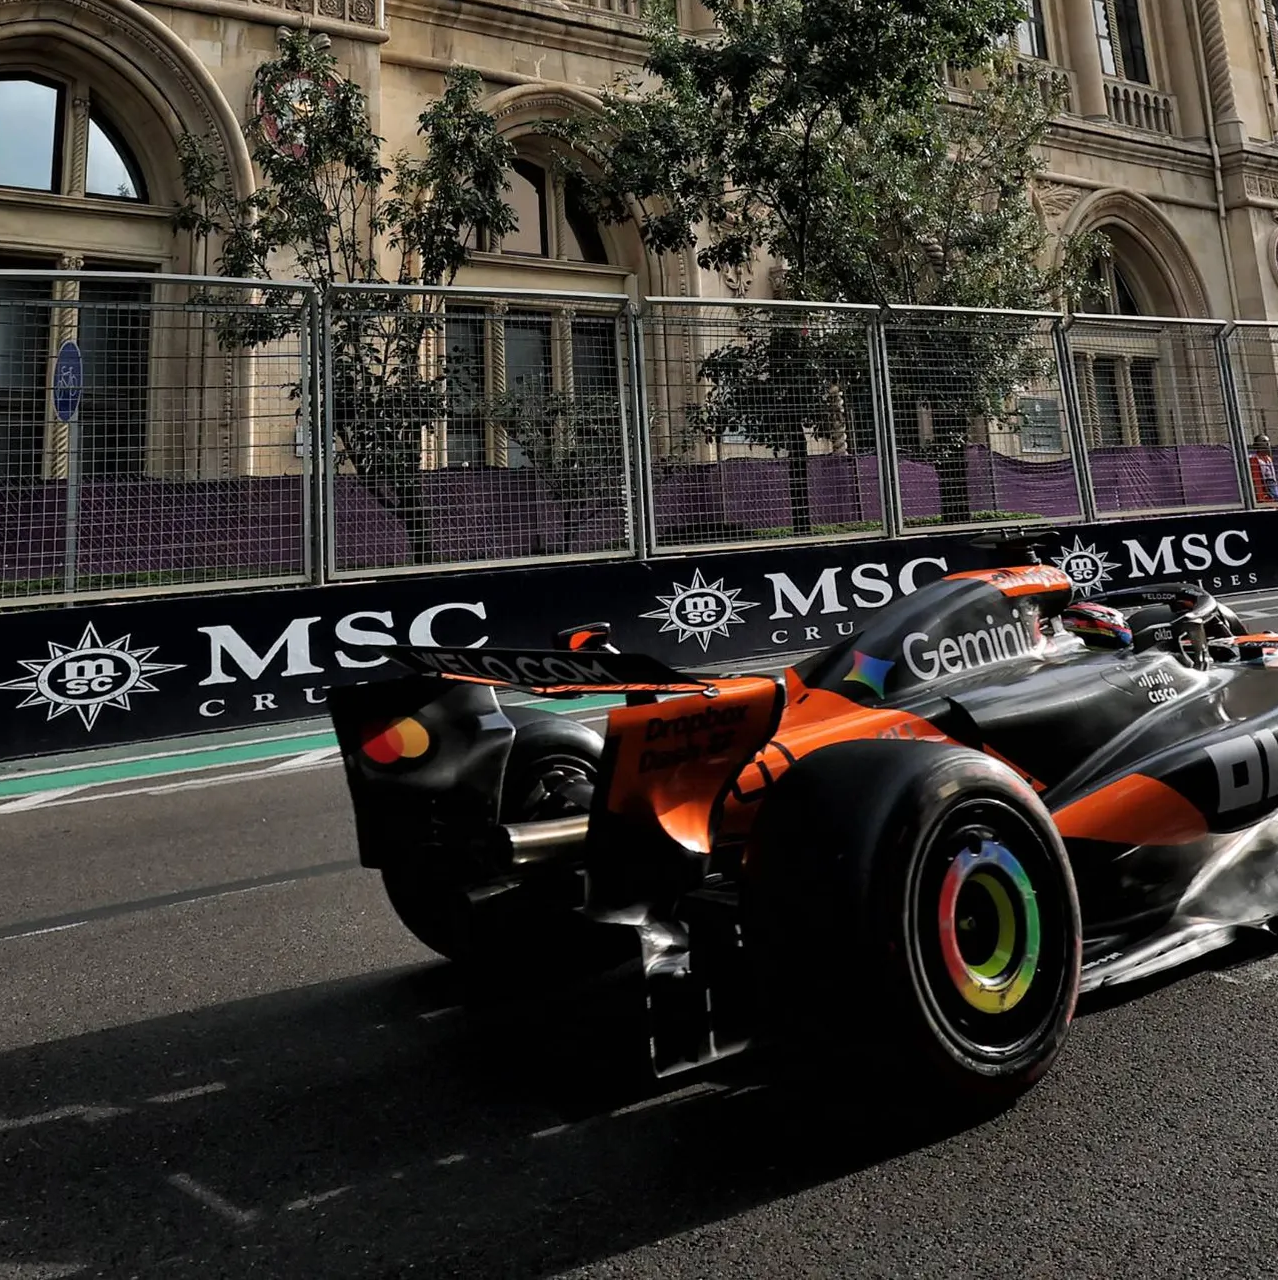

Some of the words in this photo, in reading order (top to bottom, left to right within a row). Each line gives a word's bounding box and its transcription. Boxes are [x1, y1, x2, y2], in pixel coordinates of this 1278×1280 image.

[1122, 529, 1252, 579] MSC
[764, 557, 949, 620] MSC
[197, 601, 490, 687] MSC
[902, 608, 1029, 680] Gemini
[646, 704, 749, 741] Dropbox
